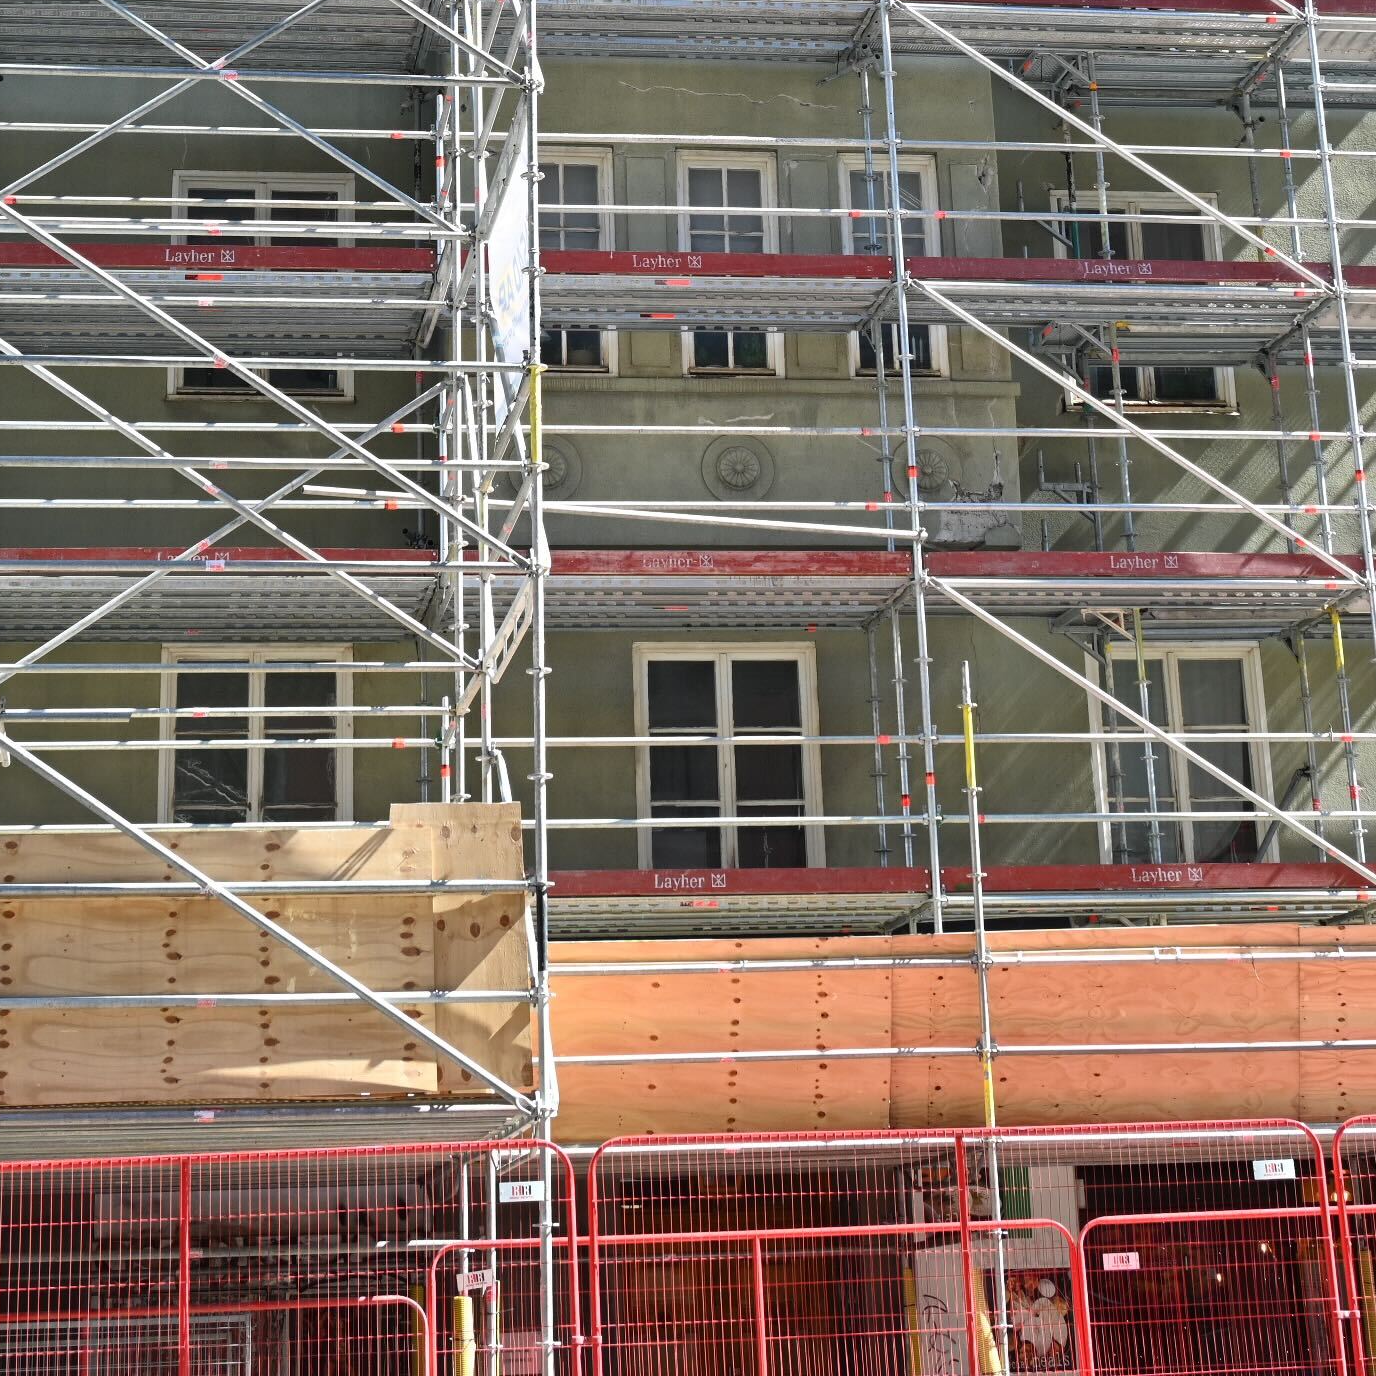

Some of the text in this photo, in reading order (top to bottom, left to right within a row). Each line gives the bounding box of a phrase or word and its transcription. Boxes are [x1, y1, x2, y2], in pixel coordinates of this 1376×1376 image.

[165, 248, 214, 264] Layher
[632, 254, 682, 270] Layher
[1085, 261, 1131, 277] Layher
[1110, 554, 1158, 570] Layher
[654, 874, 704, 890] Layher
[1131, 868, 1181, 884] Layher
